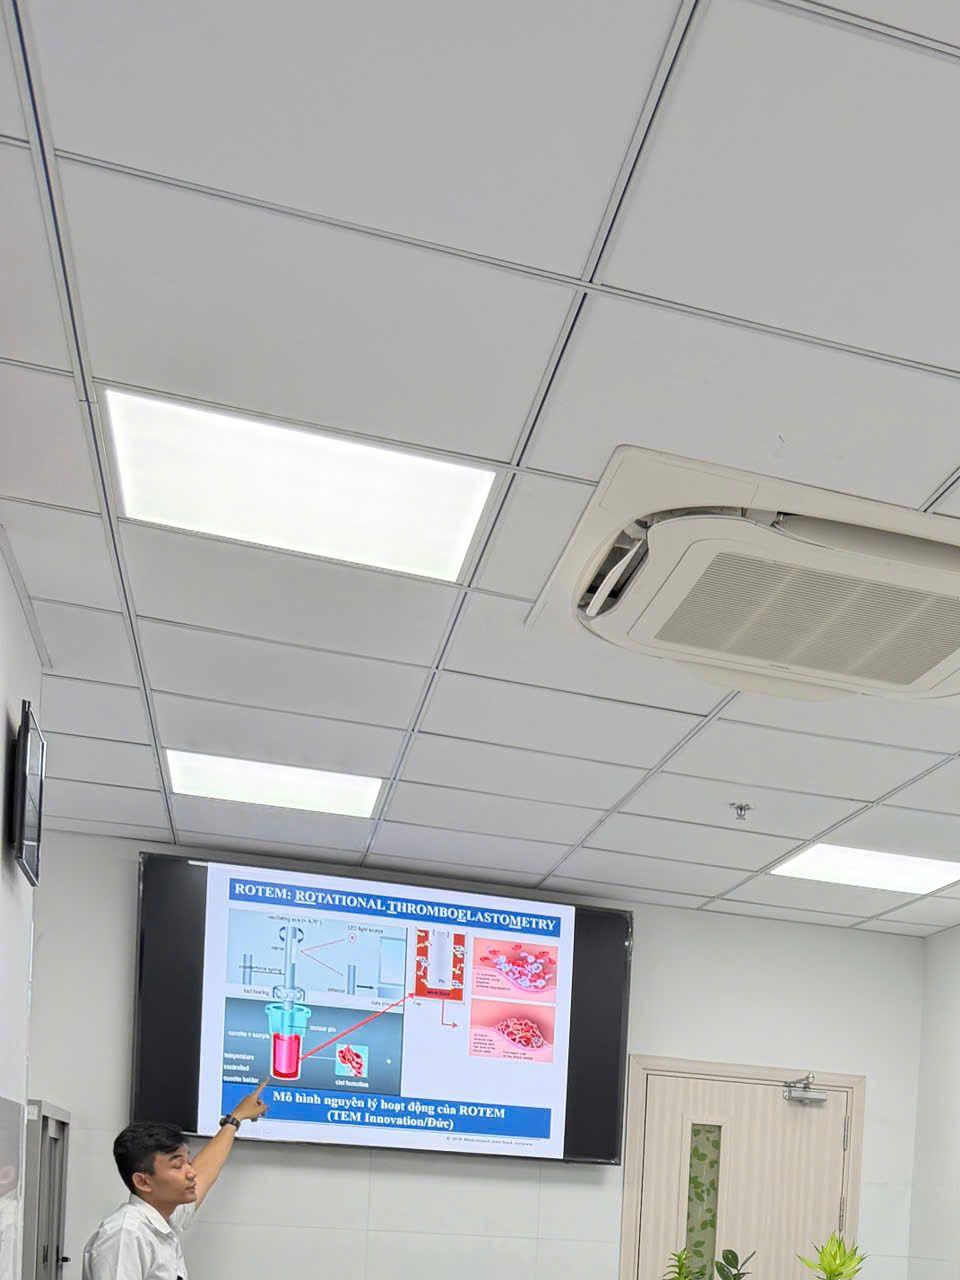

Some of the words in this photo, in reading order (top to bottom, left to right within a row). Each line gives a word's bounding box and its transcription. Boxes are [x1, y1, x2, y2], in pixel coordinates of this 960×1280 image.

[234, 883, 292, 900] ROTEM:
[294, 889, 386, 911] ROTATIONAL
[387, 900, 557, 931] THROMBOELASTOMETRY
[272, 1090, 293, 1103] Mô
[295, 1092, 321, 1105] hình
[324, 1096, 365, 1109] nguyên
[367, 1098, 378, 1111] lý
[381, 1099, 405, 1112] hoạt
[408, 1101, 435, 1115] động
[437, 1104, 456, 1115] của
[459, 1105, 505, 1119] ROTEM
[327, 1110, 361, 1122] (TEM
